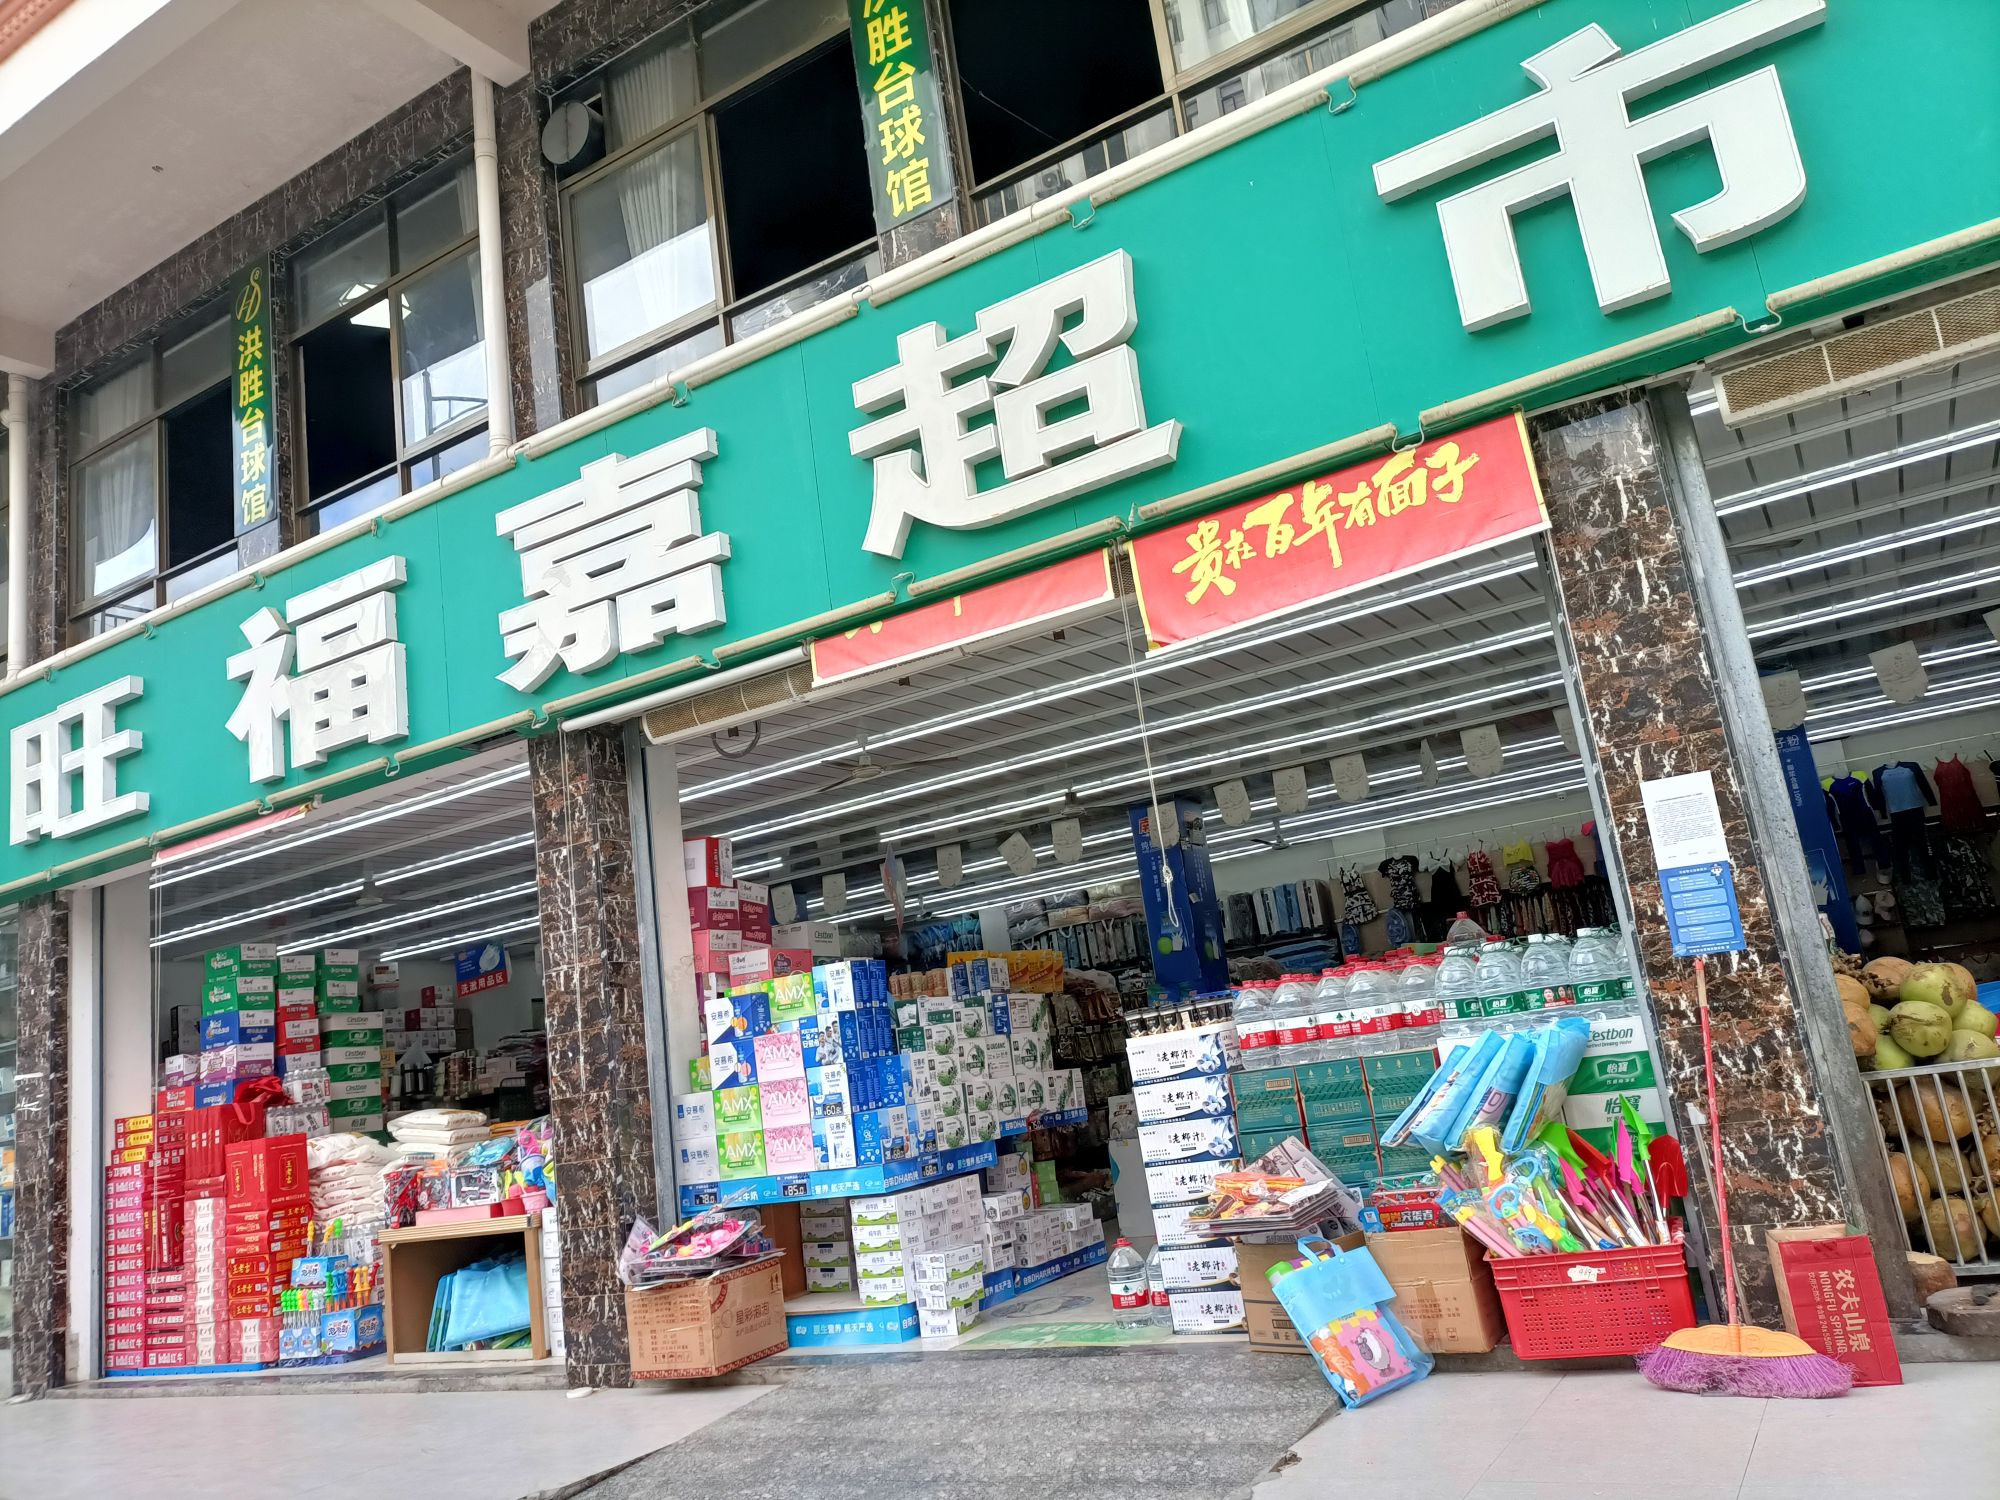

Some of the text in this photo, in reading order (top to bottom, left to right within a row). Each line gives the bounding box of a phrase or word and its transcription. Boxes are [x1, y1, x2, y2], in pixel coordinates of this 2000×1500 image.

[863, 0, 933, 218] 胜台球馆
[9, 0, 1826, 847] 旺福嘉超市
[236, 325, 269, 525] 洪胜台球馆
[1172, 440, 1480, 606] 贵在百年有面子
[774, 985, 808, 1003] AMX
[762, 1044, 798, 1061] AMX
[721, 1096, 754, 1114] AMX
[766, 1090, 803, 1107] AMX
[725, 1141, 758, 1159] AMX
[773, 1135, 807, 1153] AMX
[1818, 1270, 1848, 1353] NONGFU SPRING
[1832, 1268, 1871, 1352] 农夫山泉
